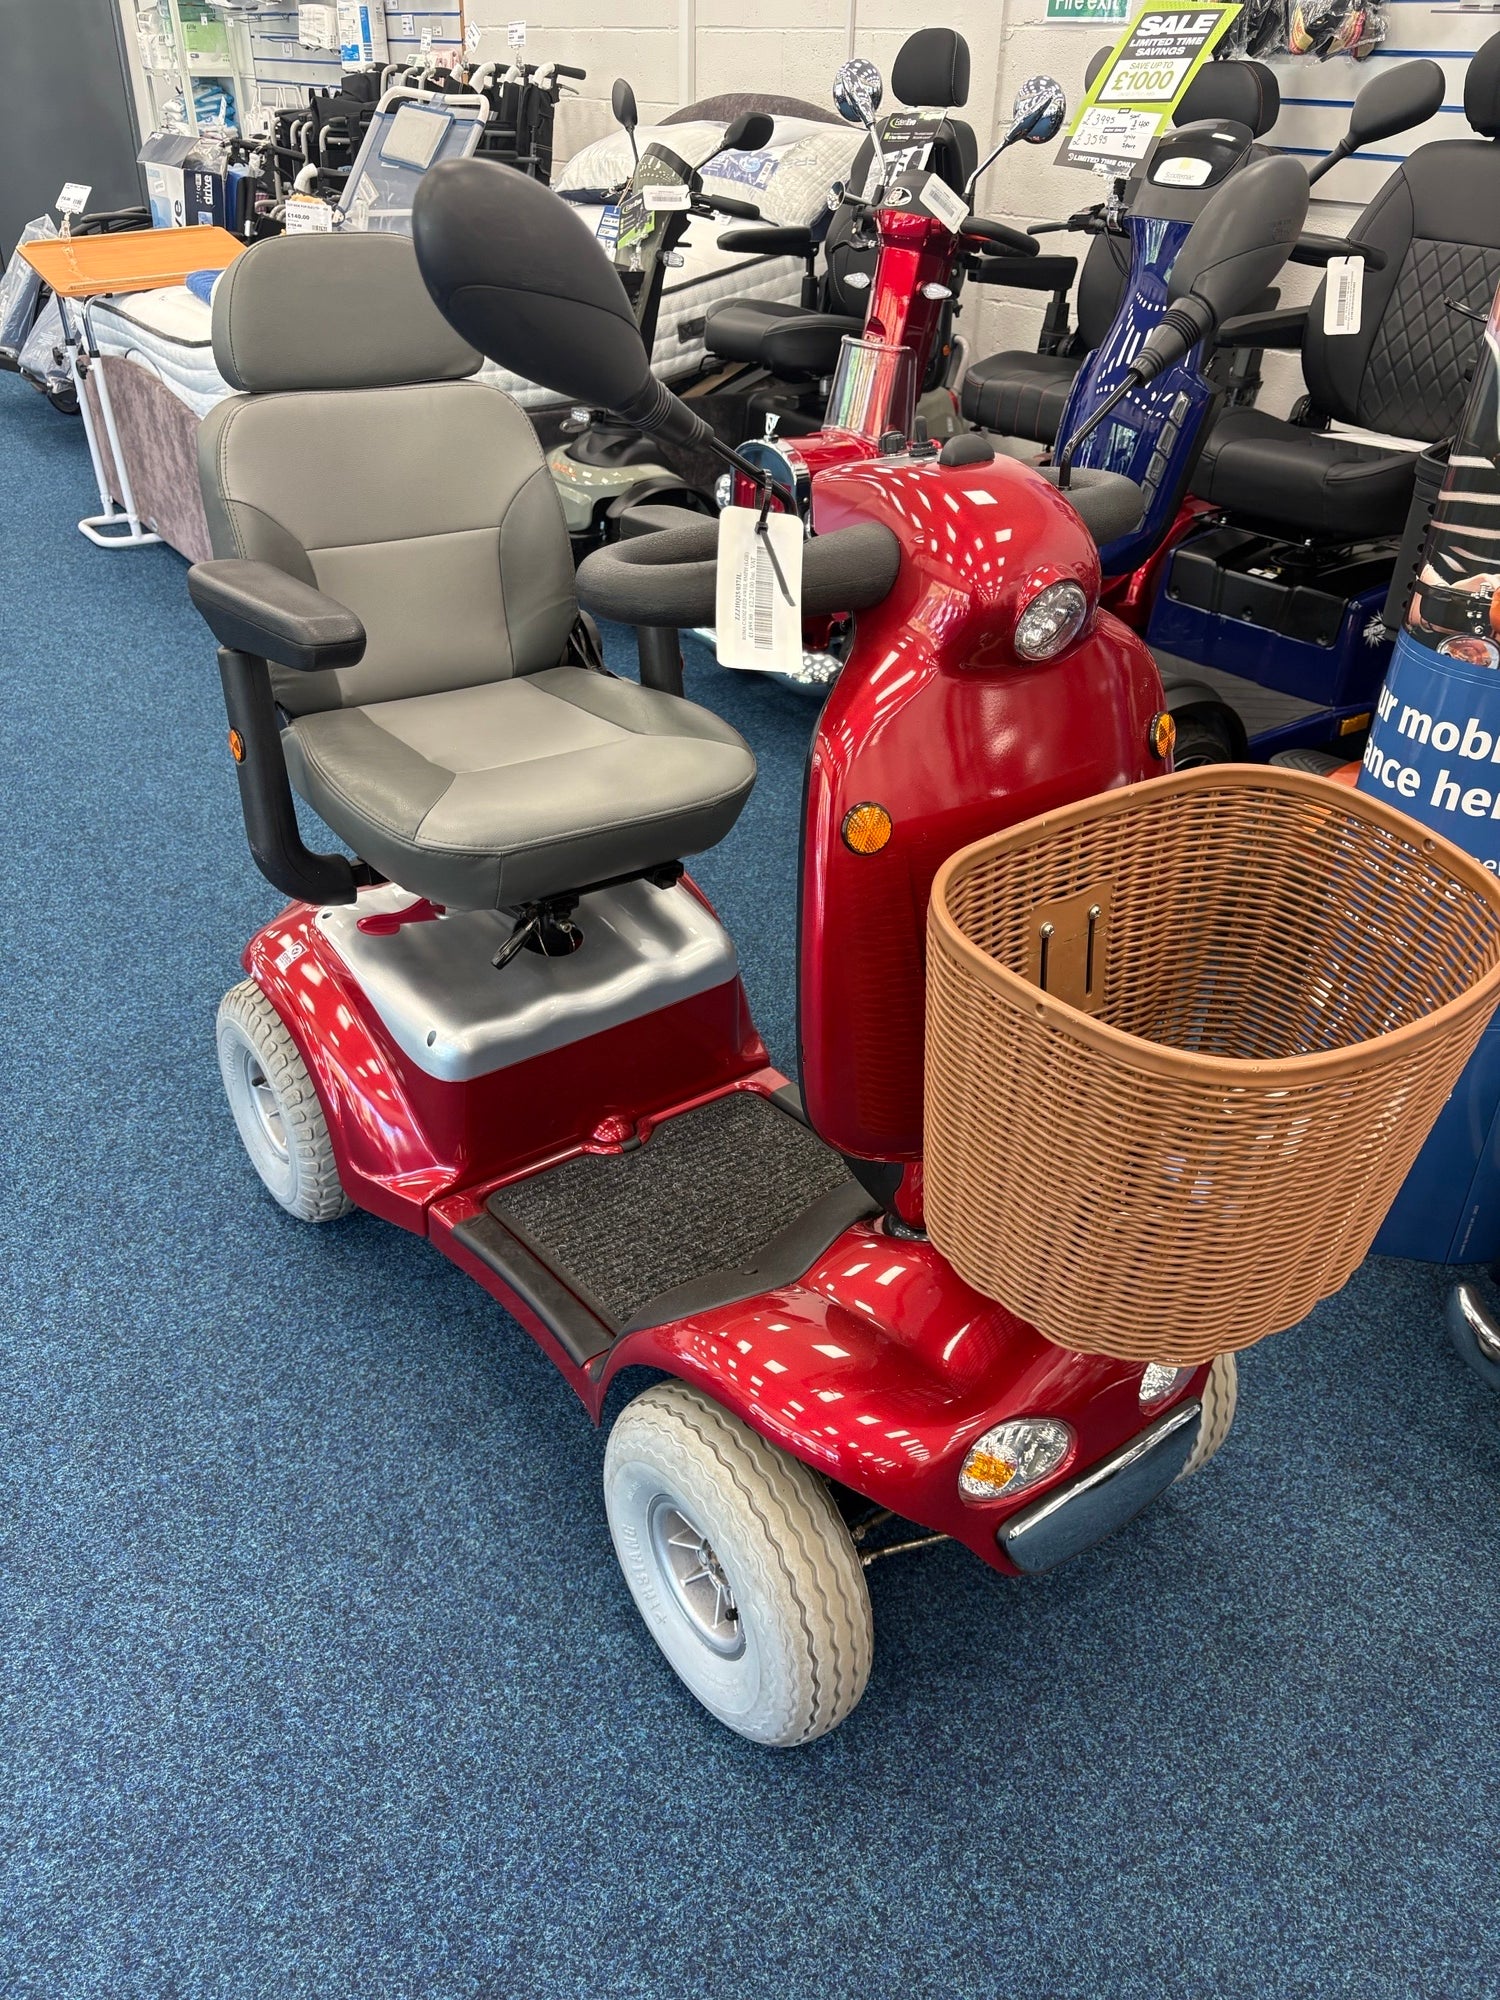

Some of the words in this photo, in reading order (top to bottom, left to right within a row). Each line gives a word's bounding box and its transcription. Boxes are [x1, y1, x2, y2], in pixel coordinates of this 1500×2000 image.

[1055, 0, 1084, 10] Fire
[1087, 0, 1120, 11] exit
[1136, 13, 1220, 37] SALE
[1129, 37, 1175, 48] LIMITED
[1176, 36, 1205, 46] TIME
[1135, 46, 1187, 57] SAVINGS
[1129, 62, 1150, 70] SAVE
[1150, 61, 1163, 69] UP
[1162, 61, 1174, 69] TO
[1111, 70, 1175, 91] £1000
[1073, 154, 1100, 163] LIMITED
[1100, 158, 1117, 166] TIME
[1116, 160, 1137, 169] ONLY
[203, 174, 214, 206] drive
